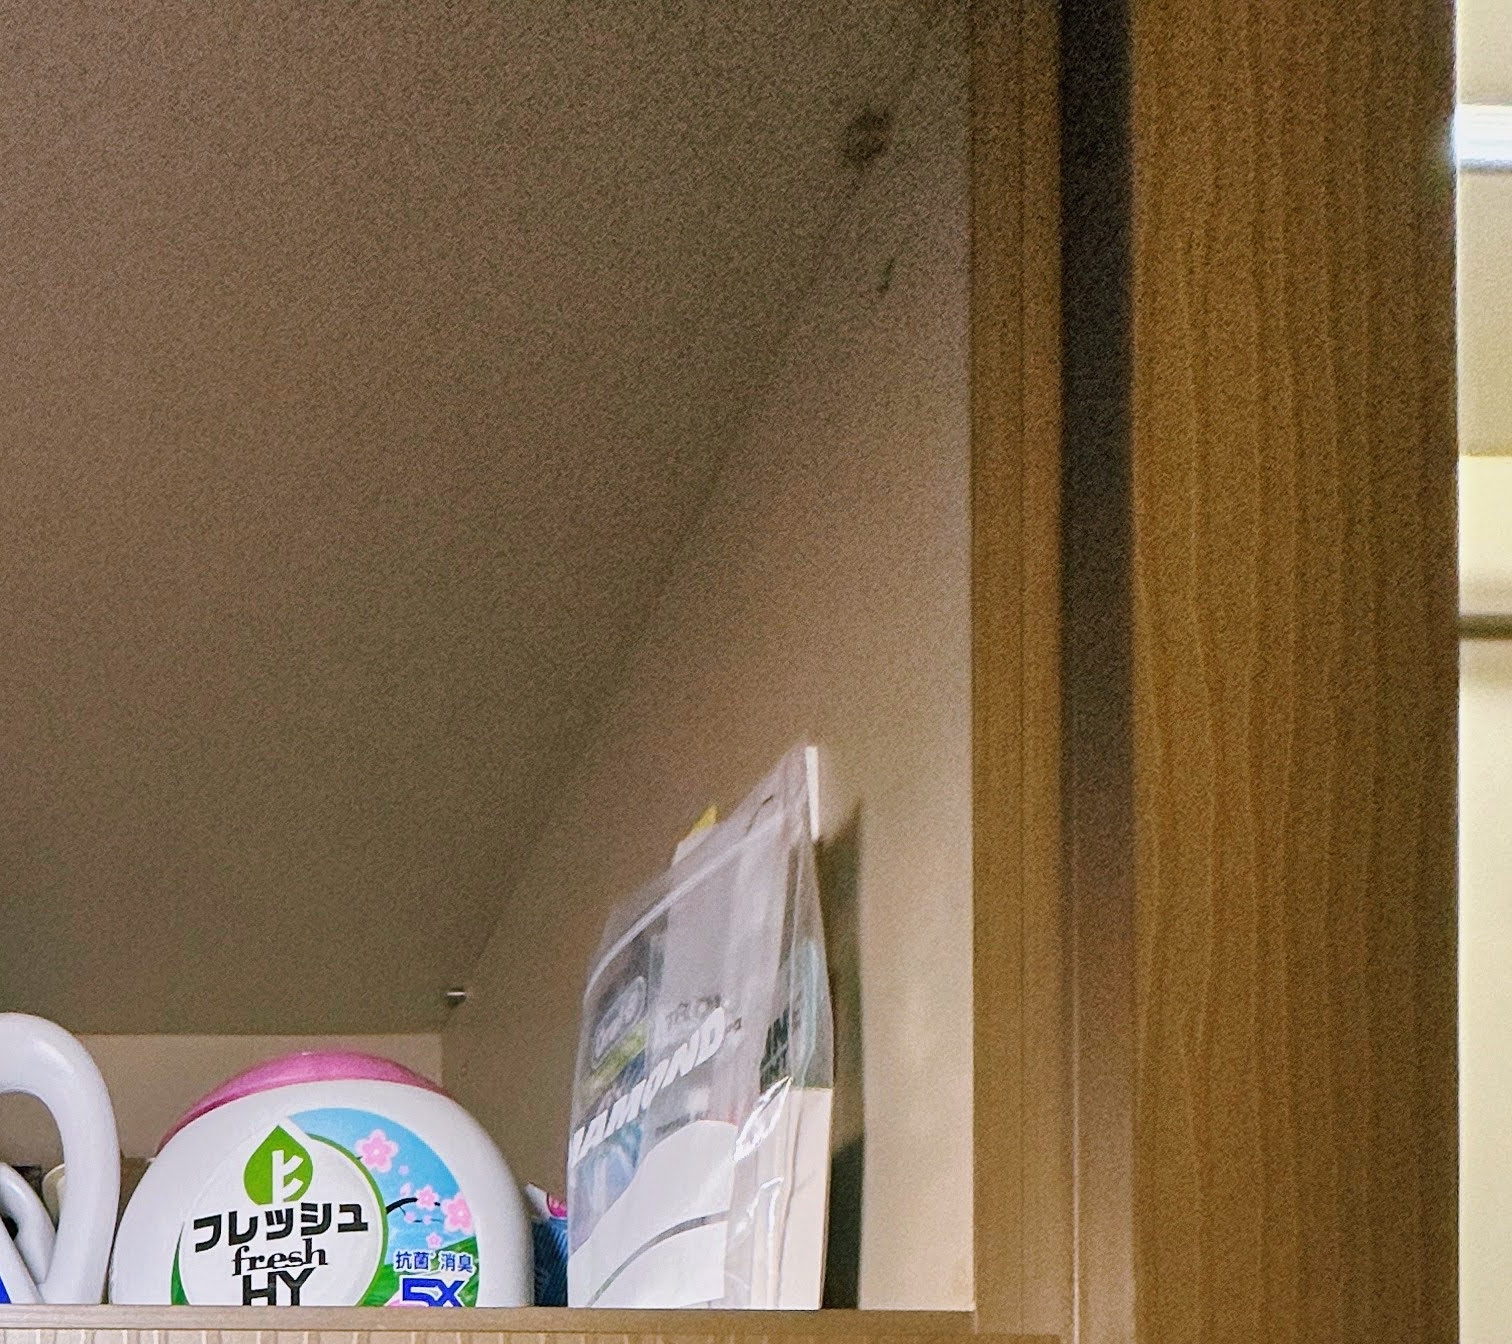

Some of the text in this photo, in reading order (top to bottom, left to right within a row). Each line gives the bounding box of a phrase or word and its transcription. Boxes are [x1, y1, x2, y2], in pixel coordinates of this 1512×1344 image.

[193, 1202, 369, 1253] フレッシュ
[231, 1237, 329, 1277] fresh
[396, 1250, 429, 1270] 抗菌
[242, 1266, 316, 1306] HY
[402, 1278, 465, 1307] 5X
